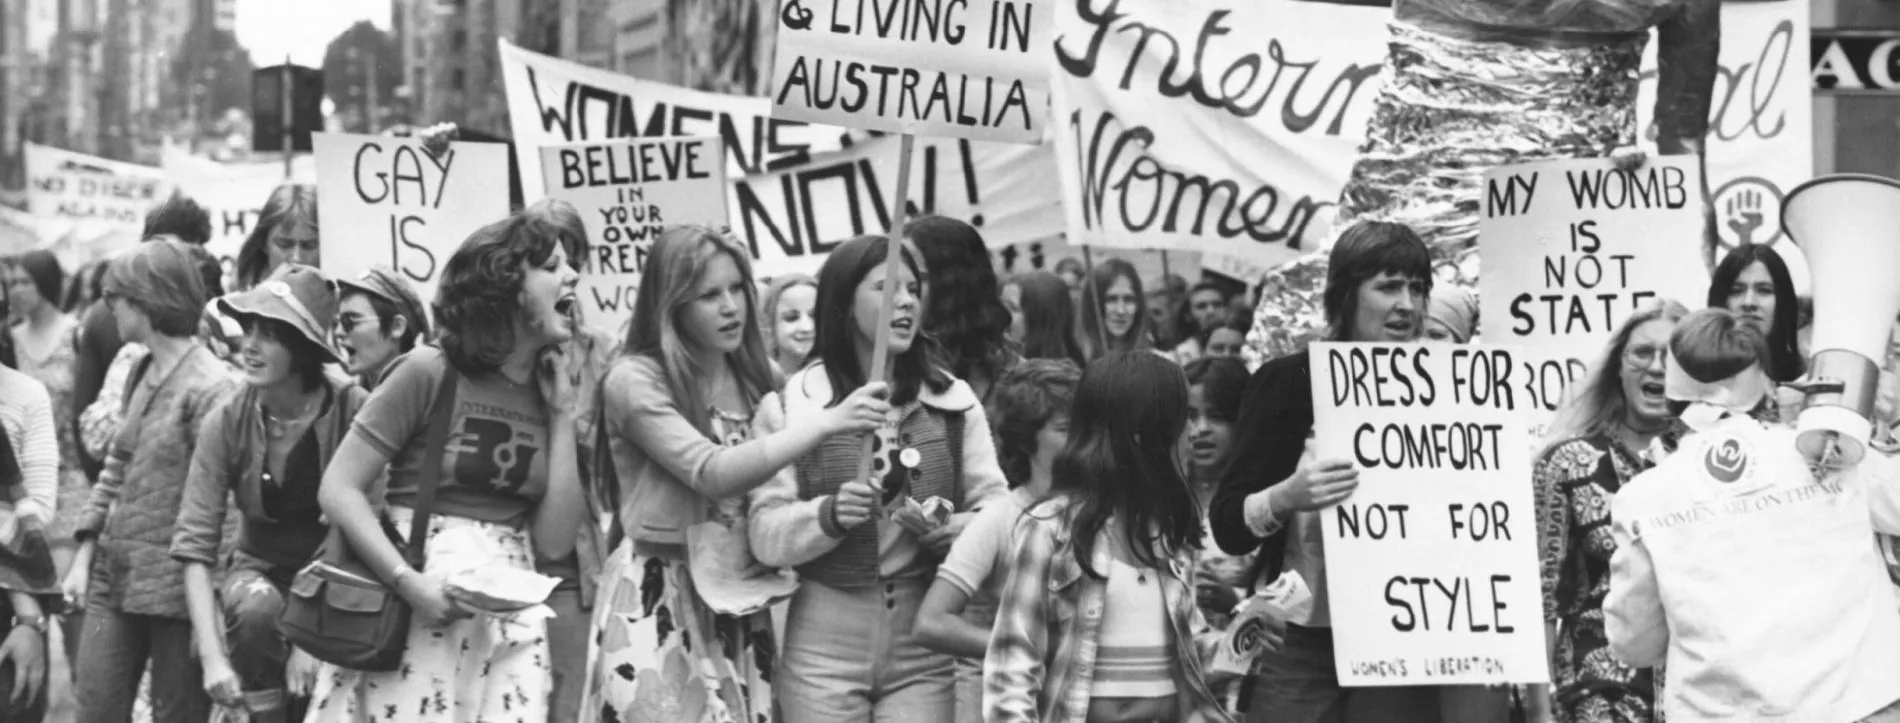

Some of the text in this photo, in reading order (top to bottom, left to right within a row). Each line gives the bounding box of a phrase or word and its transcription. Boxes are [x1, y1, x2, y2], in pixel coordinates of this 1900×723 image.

[781, 0, 1032, 53] & LIVING IN
[1053, 0, 1386, 136] Intern
[1706, 19, 1793, 141] al
[777, 56, 1032, 131] AUSTRALIA
[354, 142, 455, 209] GAY
[560, 142, 711, 189] BELIEVE
[1070, 108, 1340, 250] Women
[598, 204, 663, 225] YOUR
[617, 187, 643, 204] IN
[1488, 166, 1687, 218] MY WOMB
[391, 213, 436, 283] IS
[603, 225, 664, 243] OWN
[1570, 220, 1601, 254] IS
[587, 244, 649, 274] TREN
[1544, 255, 1635, 289] NOT
[592, 285, 639, 313] WO
[1329, 347, 1515, 410] DRESS FOR
[1354, 422, 1503, 470] COMFORT
[1336, 500, 1512, 541] NOT FOR
[1648, 507, 1717, 528] WOMEN
[1722, 499, 1752, 516] ARE
[1755, 494, 1781, 511] ON
[1385, 574, 1514, 634] STYLE
[1351, 658, 1408, 677] WOMEN'S
